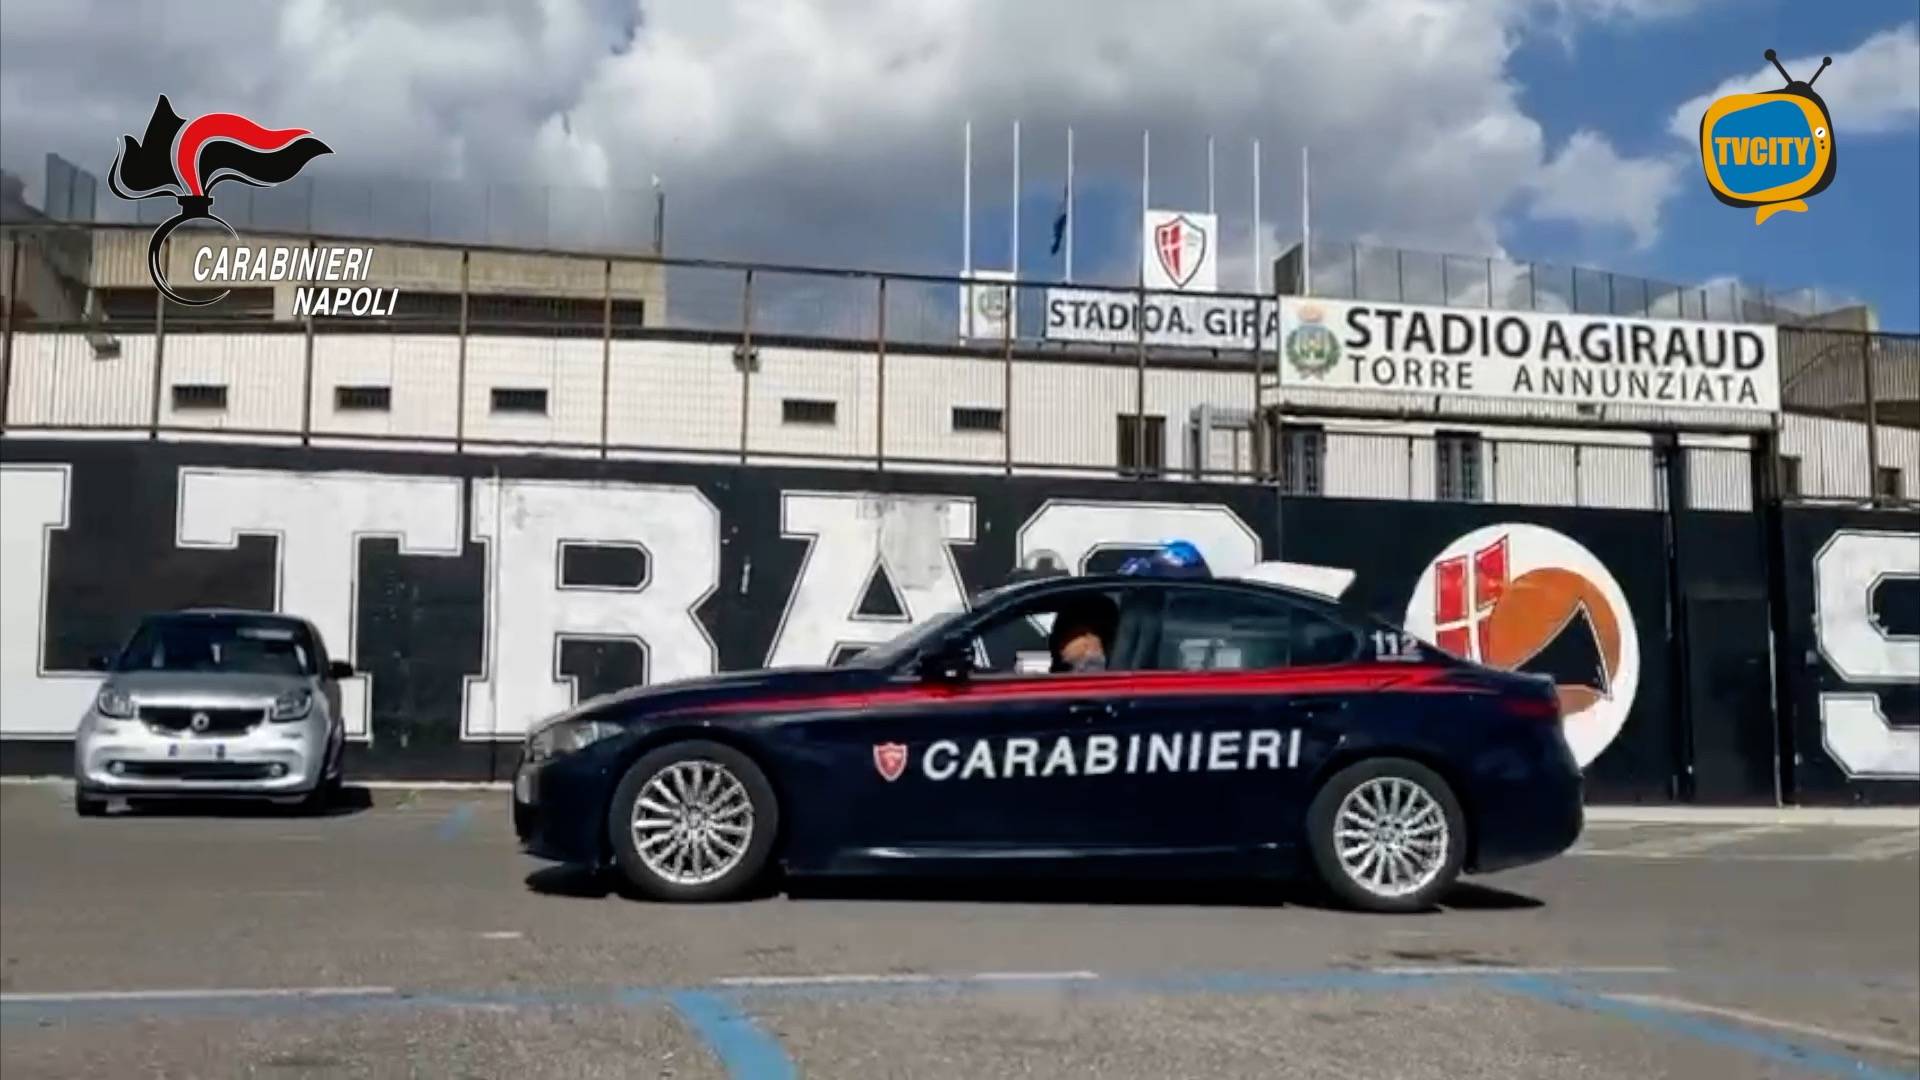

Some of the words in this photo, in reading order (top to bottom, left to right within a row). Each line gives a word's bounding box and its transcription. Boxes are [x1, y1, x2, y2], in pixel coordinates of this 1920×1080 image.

[1345, 306, 1531, 359] STADIO
[1348, 354, 1473, 390] TORRE
[1512, 364, 1758, 404] ANNUNZIATA
[922, 728, 1302, 781] CARABINIERI
